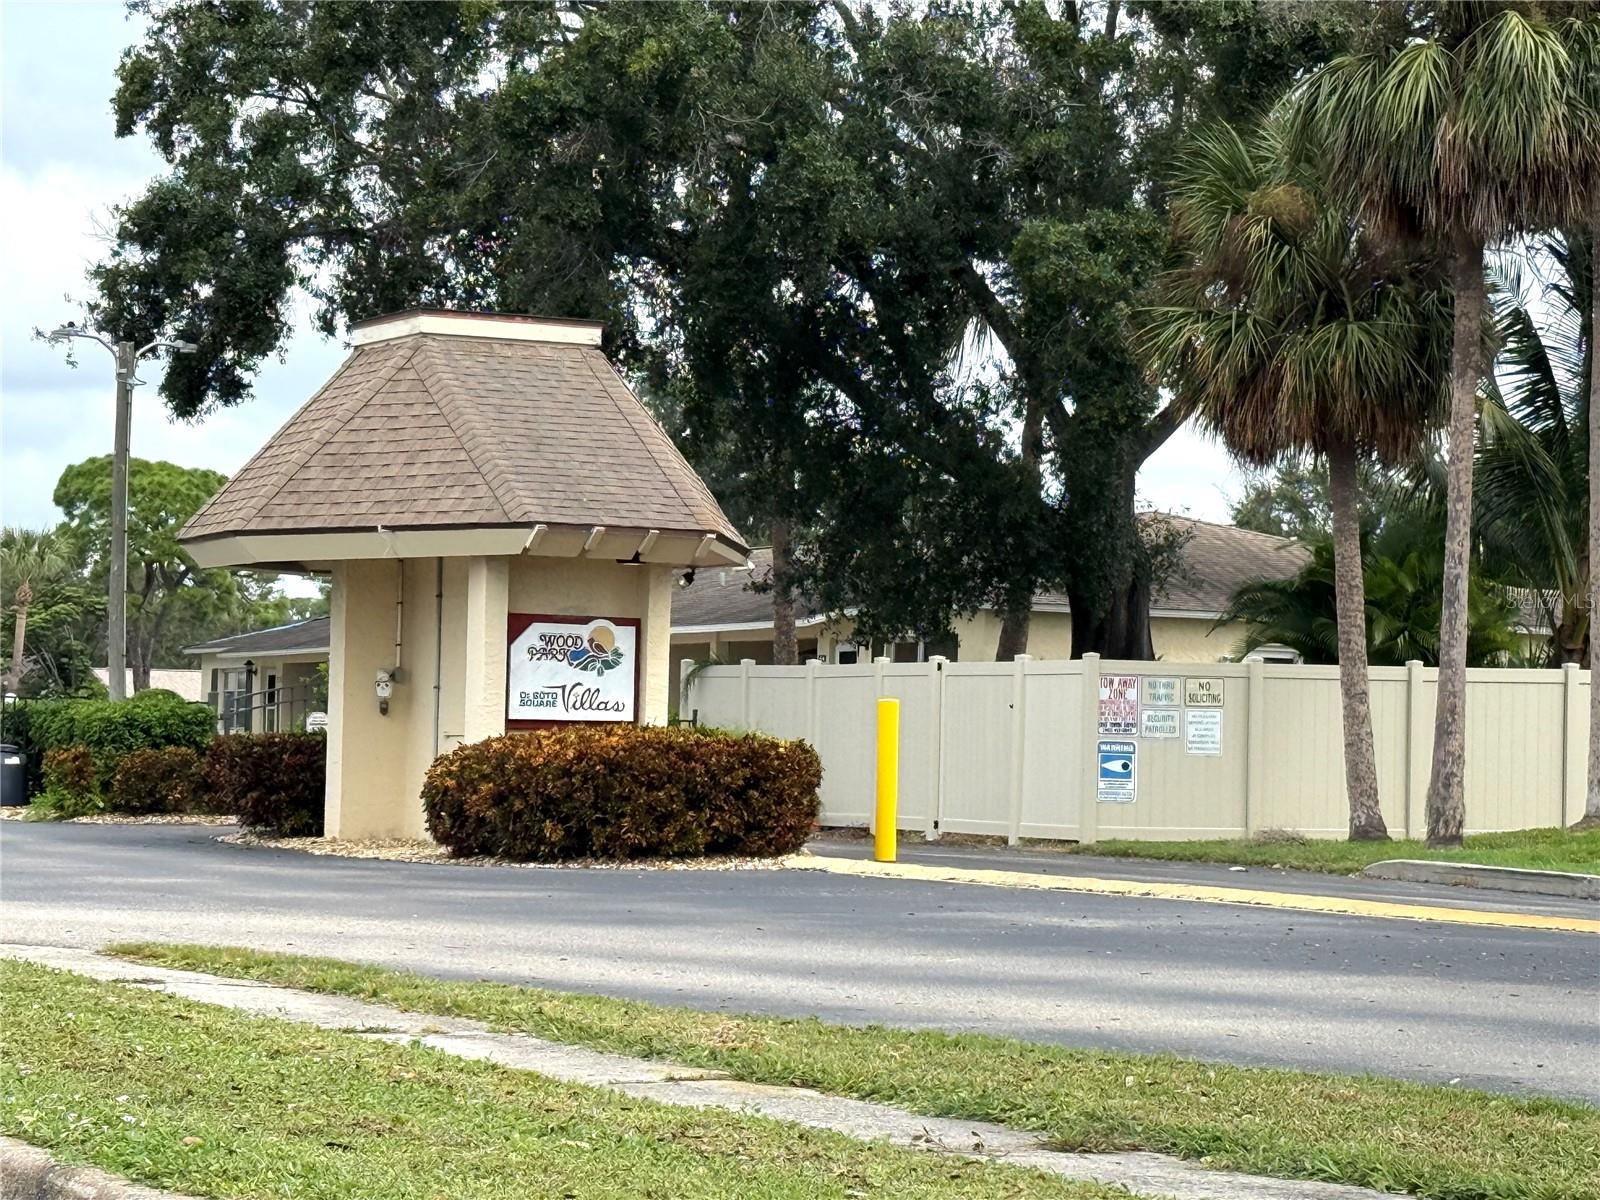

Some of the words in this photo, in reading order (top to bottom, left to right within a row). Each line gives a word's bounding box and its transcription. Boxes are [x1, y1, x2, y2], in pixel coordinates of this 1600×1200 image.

[539, 633, 583, 650] WOOD
[527, 645, 575, 667] PARK
[1100, 677, 1115, 689] TOW
[1117, 677, 1137, 689] AWAY
[1198, 681, 1211, 692] NO
[532, 691, 558, 700] SOTO
[541, 682, 625, 713] Villas
[1108, 689, 1128, 700] ZONE
[1188, 692, 1221, 704] SOLICITING
[519, 699, 558, 708] SQUARE
